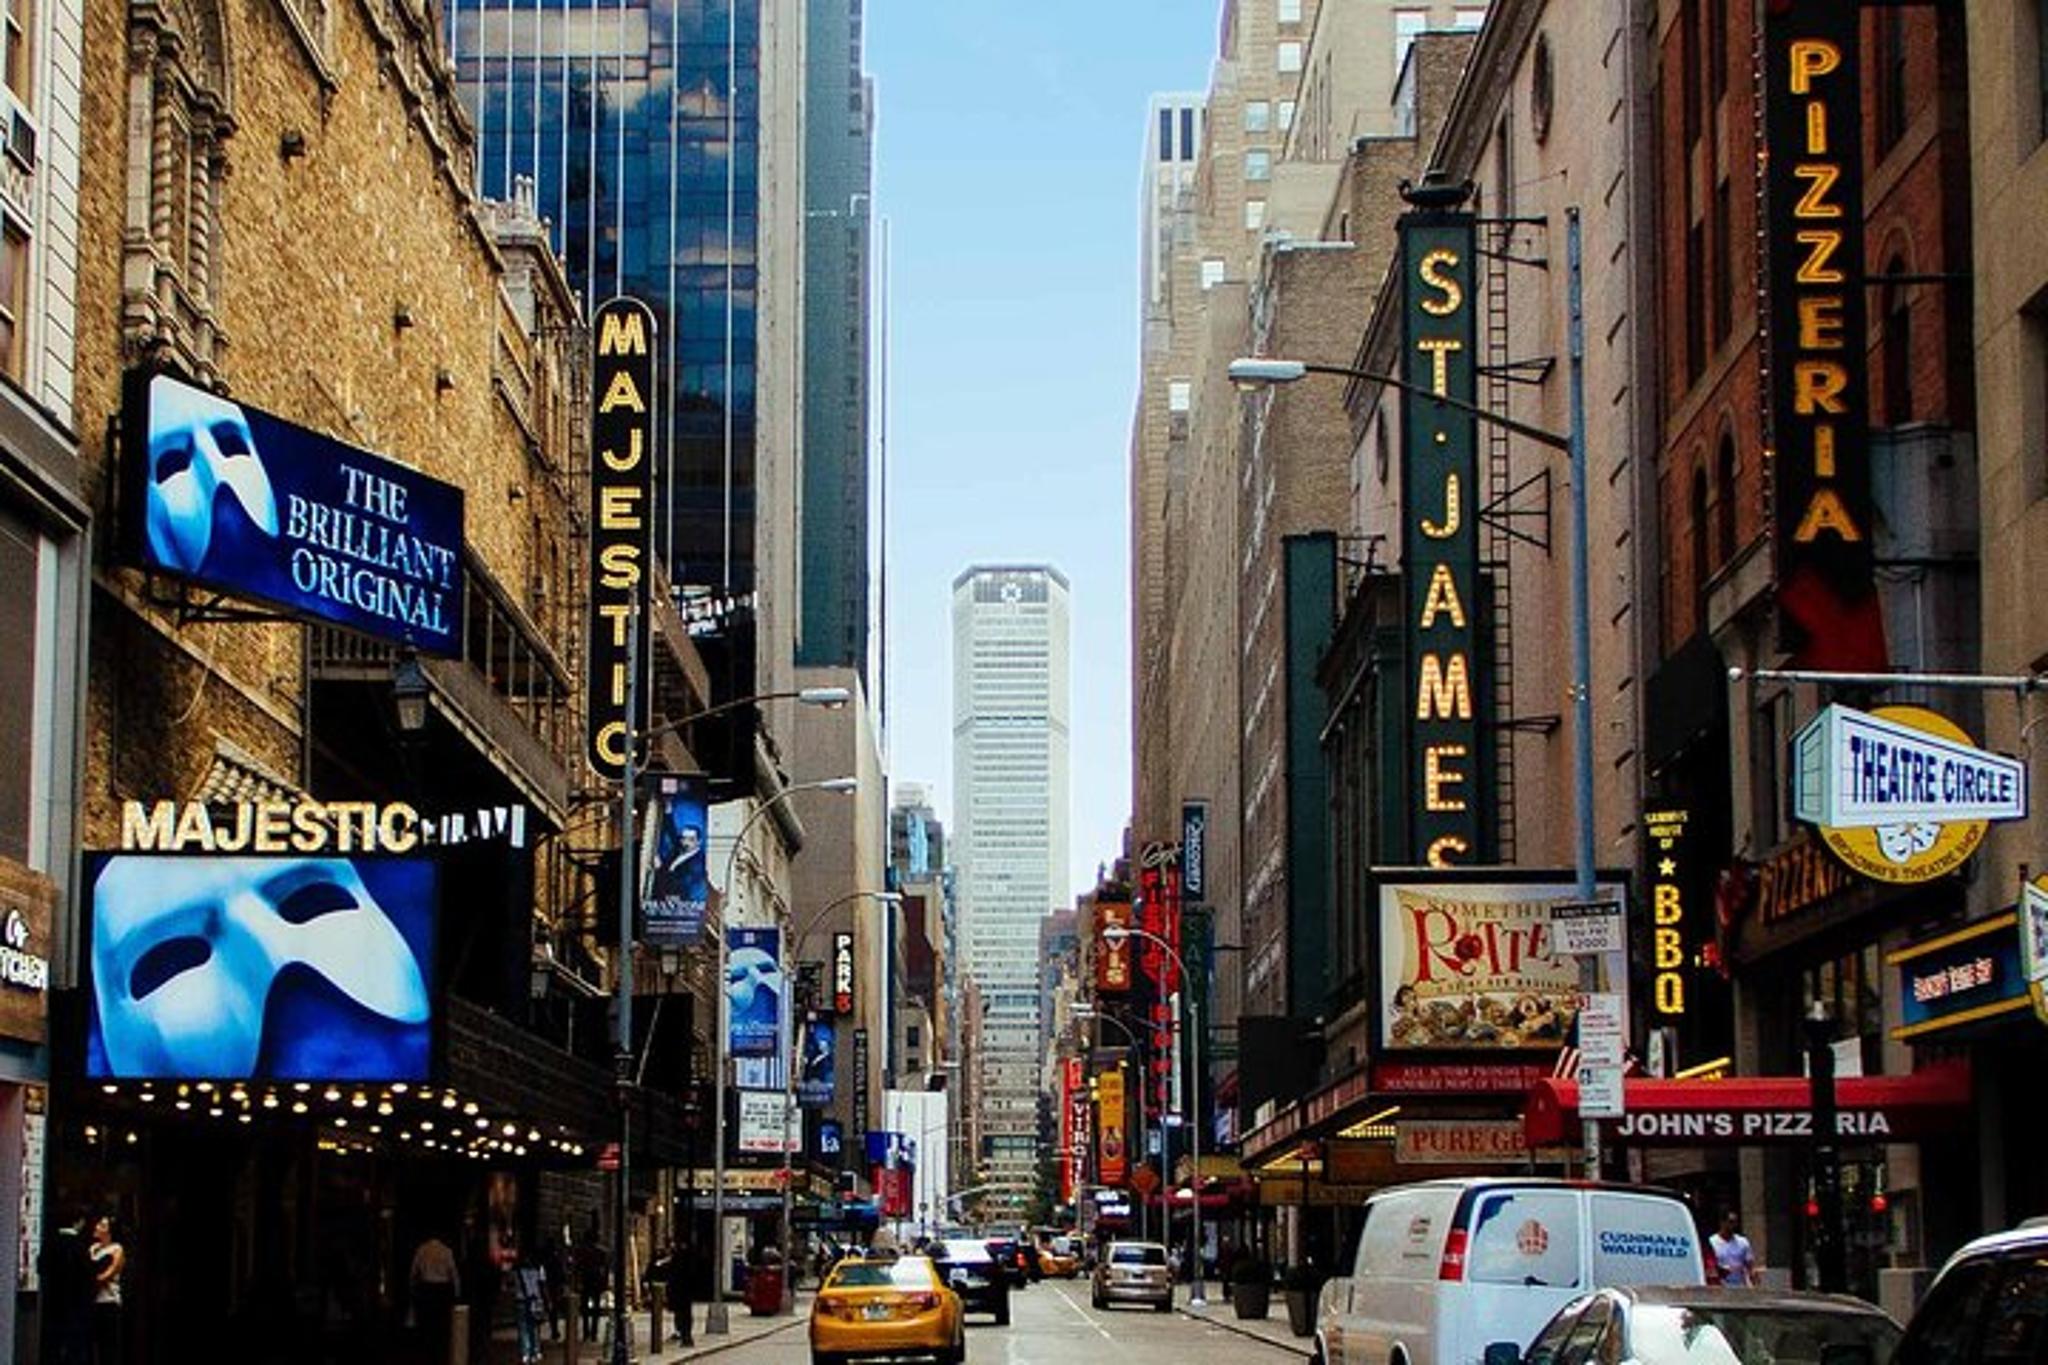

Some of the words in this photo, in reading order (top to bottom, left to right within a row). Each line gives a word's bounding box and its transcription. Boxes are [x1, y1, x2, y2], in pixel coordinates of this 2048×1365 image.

[1789, 40, 1862, 542] PIZZERIA
[340, 463, 410, 524] THE
[286, 494, 455, 591] BRILLIANT
[596, 313, 647, 766] MAJESTIC
[291, 547, 449, 635] ORIGINAL
[1851, 735, 1938, 803] THEATRE
[1942, 759, 2012, 803] CIRCLE
[121, 801, 418, 851] MAJESTIC
[1427, 899, 1544, 919] SOMETHI
[837, 935, 852, 993] PARK
[1402, 902, 1562, 984] ROTTE
[1655, 884, 1684, 1013] BBQ
[1412, 1130, 1486, 1152] PURE
[1492, 1129, 1526, 1151] GE
[1618, 1113, 1733, 1136] JOHN'S
[1743, 1113, 1889, 1136] PIZZRIA
[1599, 1230, 1677, 1245] CUSHMAN
[1680, 1234, 1691, 1247] &
[1601, 1242, 1688, 1259] WAKEFIELD
